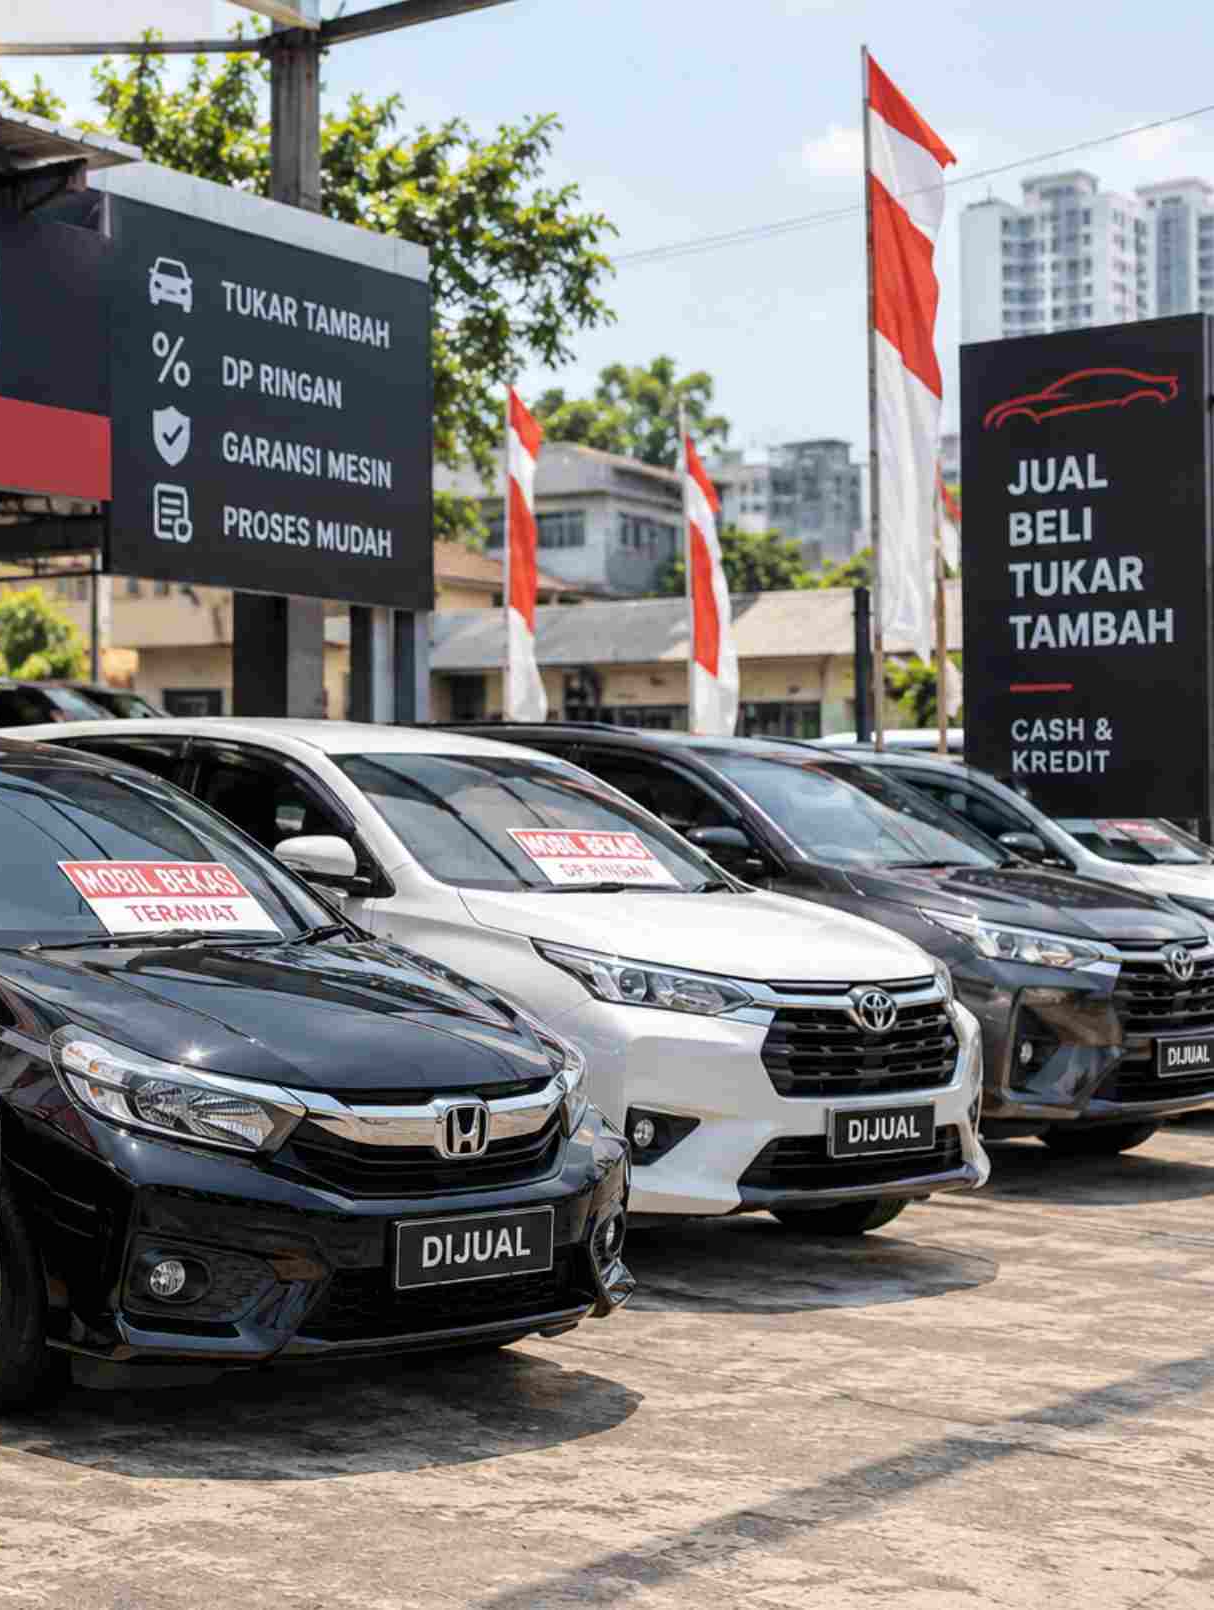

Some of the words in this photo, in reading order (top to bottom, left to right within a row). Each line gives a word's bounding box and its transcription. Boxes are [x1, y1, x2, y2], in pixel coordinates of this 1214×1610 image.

[221, 280, 298, 328] TUKAR
[303, 300, 390, 349] TAMBAH
[223, 355, 254, 390] DP
[259, 363, 342, 409] RINGAN
[222, 431, 322, 477] GARANSI
[327, 450, 392, 489] MESIN
[1007, 453, 1108, 496] JUAL
[223, 505, 311, 548] PROSES
[316, 519, 392, 558] MUDAH
[1009, 506, 1092, 547] BELI
[1008, 555, 1144, 598] TUKAR
[1009, 607, 1174, 650] TAMBAH
[1011, 718, 1084, 742] CASH
[1094, 717, 1113, 741] &
[1012, 749, 1110, 773] KREDIT
[74, 867, 160, 895] MOBIL
[157, 868, 239, 895] BEKAS
[124, 904, 239, 923] TERAWAT
[1167, 1044, 1211, 1067] DIJUAL
[848, 1115, 921, 1144] DIJUAL
[421, 1226, 531, 1268] DIJUAL
